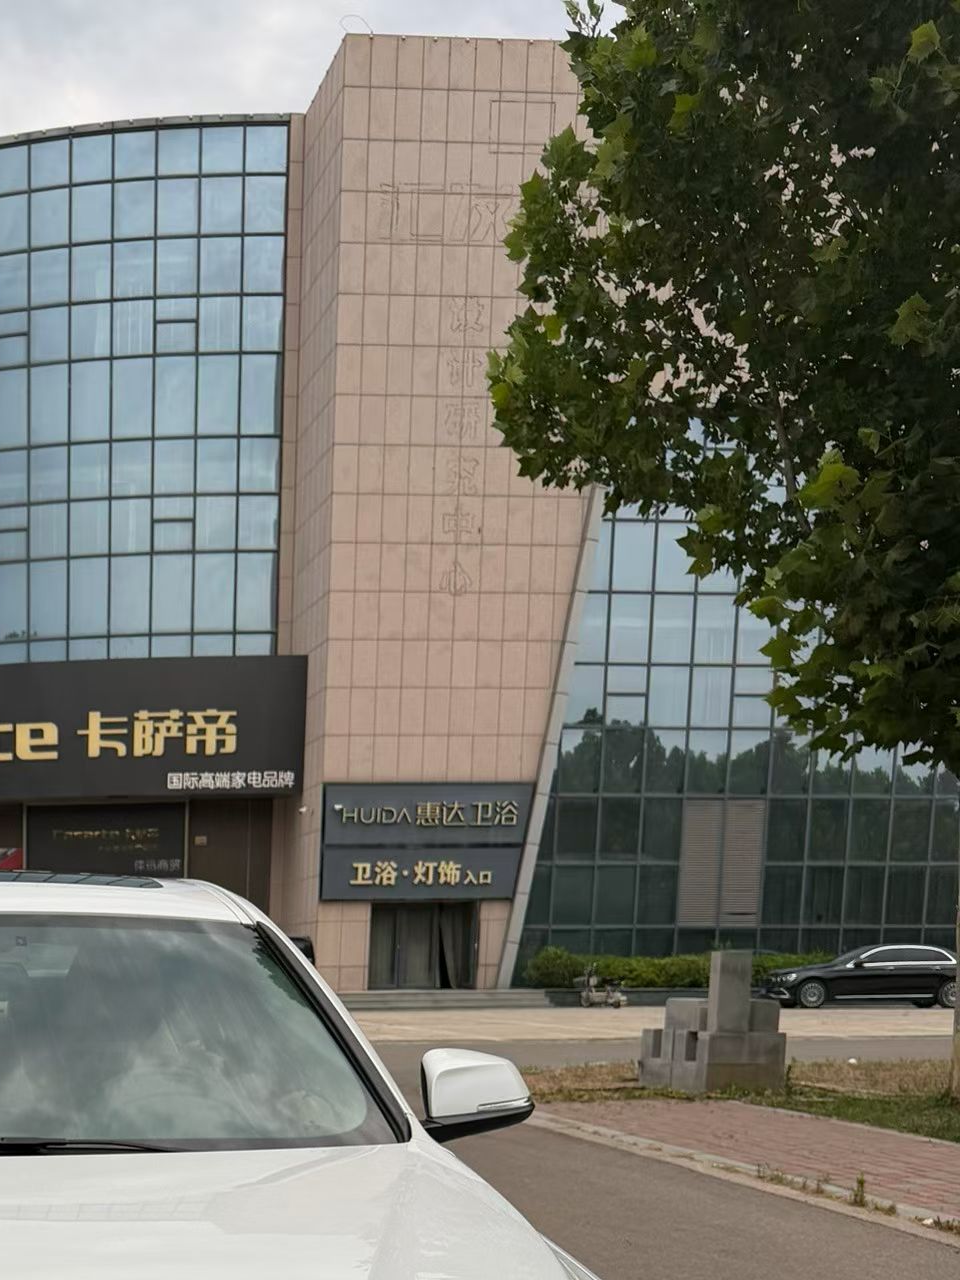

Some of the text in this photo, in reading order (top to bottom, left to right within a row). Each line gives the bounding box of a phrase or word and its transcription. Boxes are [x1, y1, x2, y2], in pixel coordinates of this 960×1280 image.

[77, 709, 237, 758] 卡萨帝
[167, 770, 295, 790] 国际高端家电品牌
[342, 800, 519, 826] HUIDA 惠达卫浴
